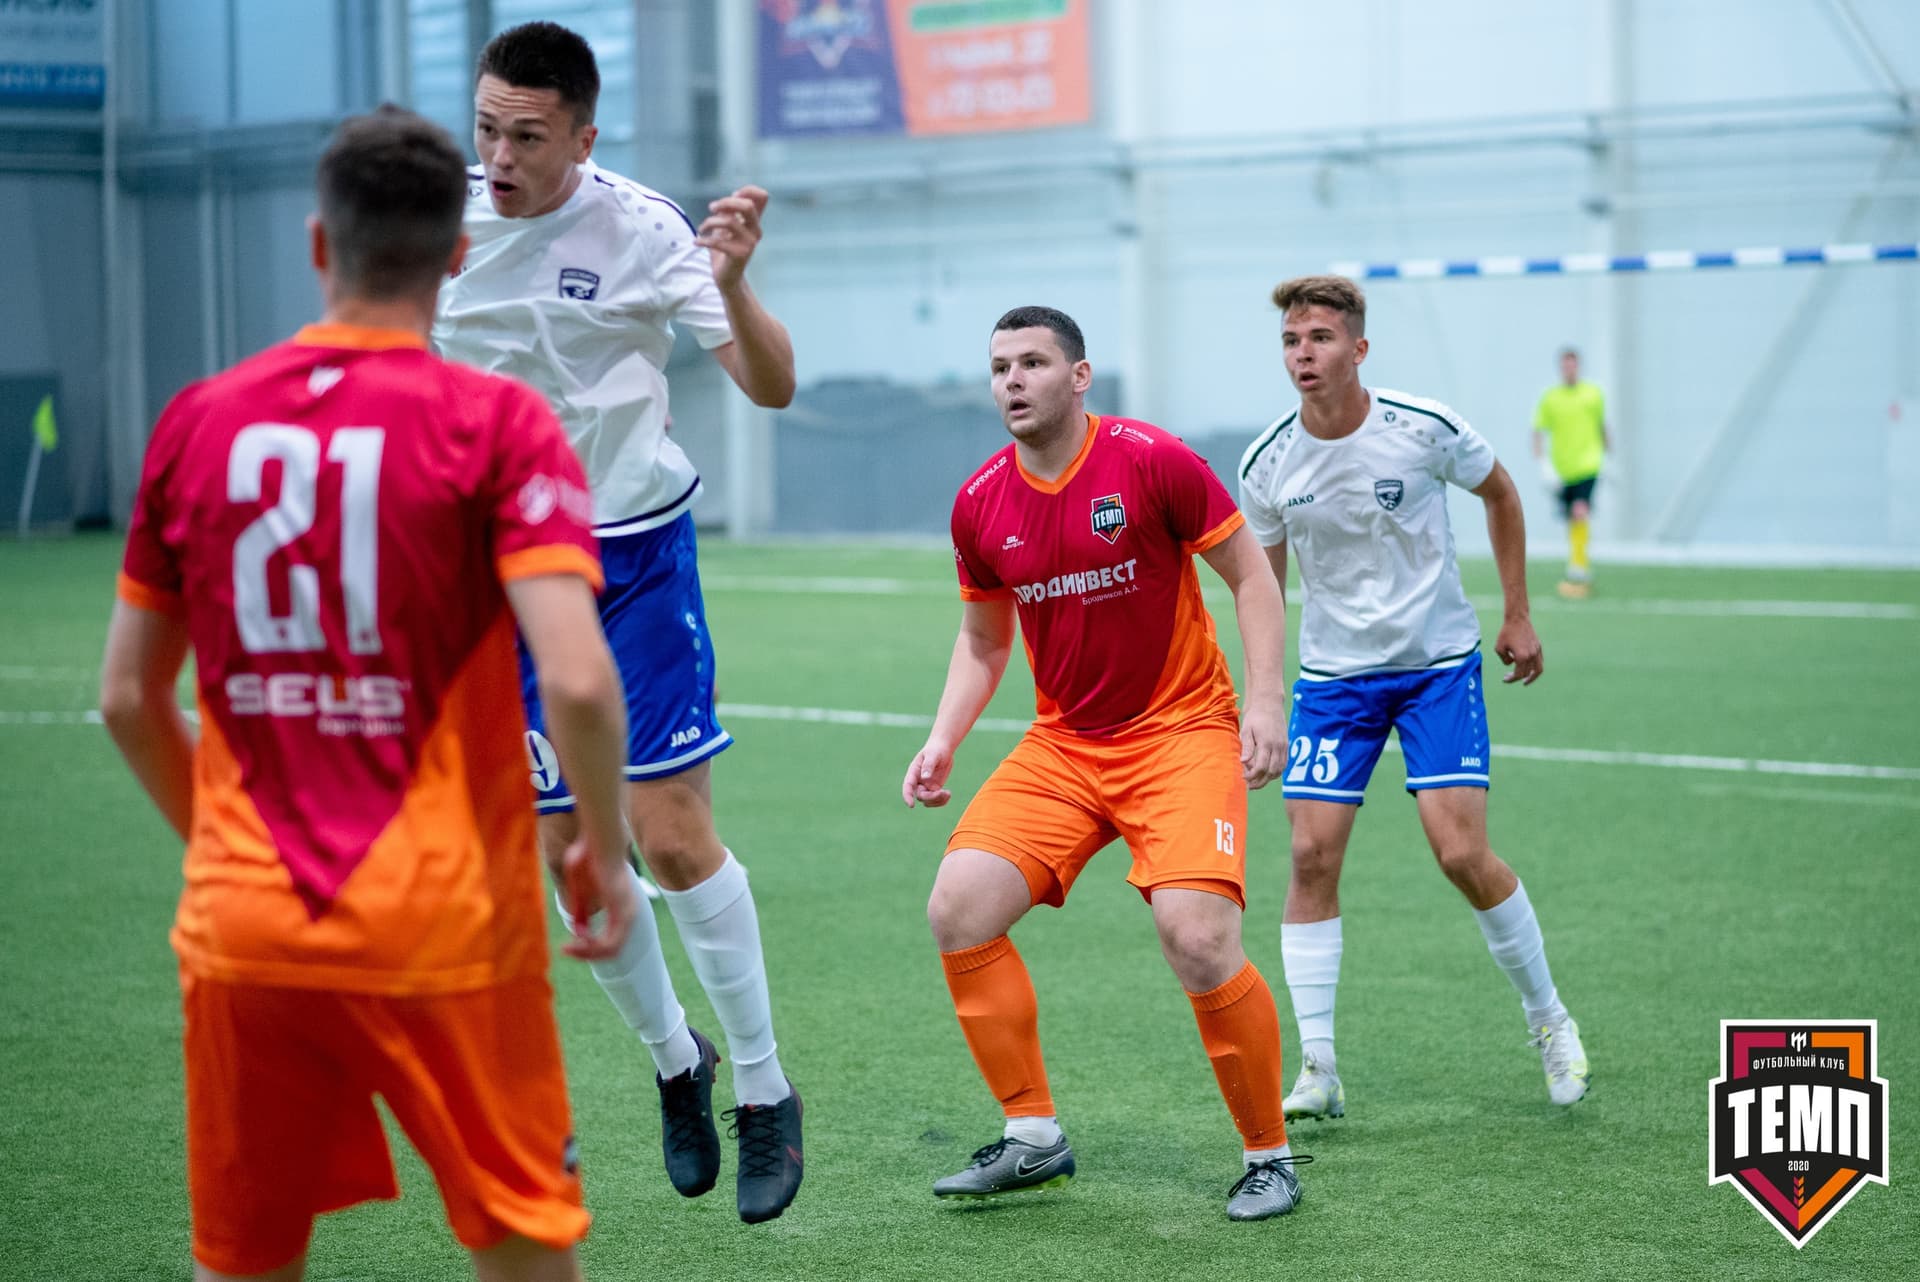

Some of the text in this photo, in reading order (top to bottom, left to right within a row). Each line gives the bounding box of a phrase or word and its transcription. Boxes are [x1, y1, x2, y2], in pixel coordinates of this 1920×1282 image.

[1094, 508, 1123, 529] ТЕМП
[1287, 494, 1315, 508] JAKO
[226, 421, 386, 655] 21
[225, 673, 405, 718] SEUS
[1286, 735, 1340, 784] 25
[1460, 756, 1481, 768] JAKO
[1213, 818, 1235, 856] 13
